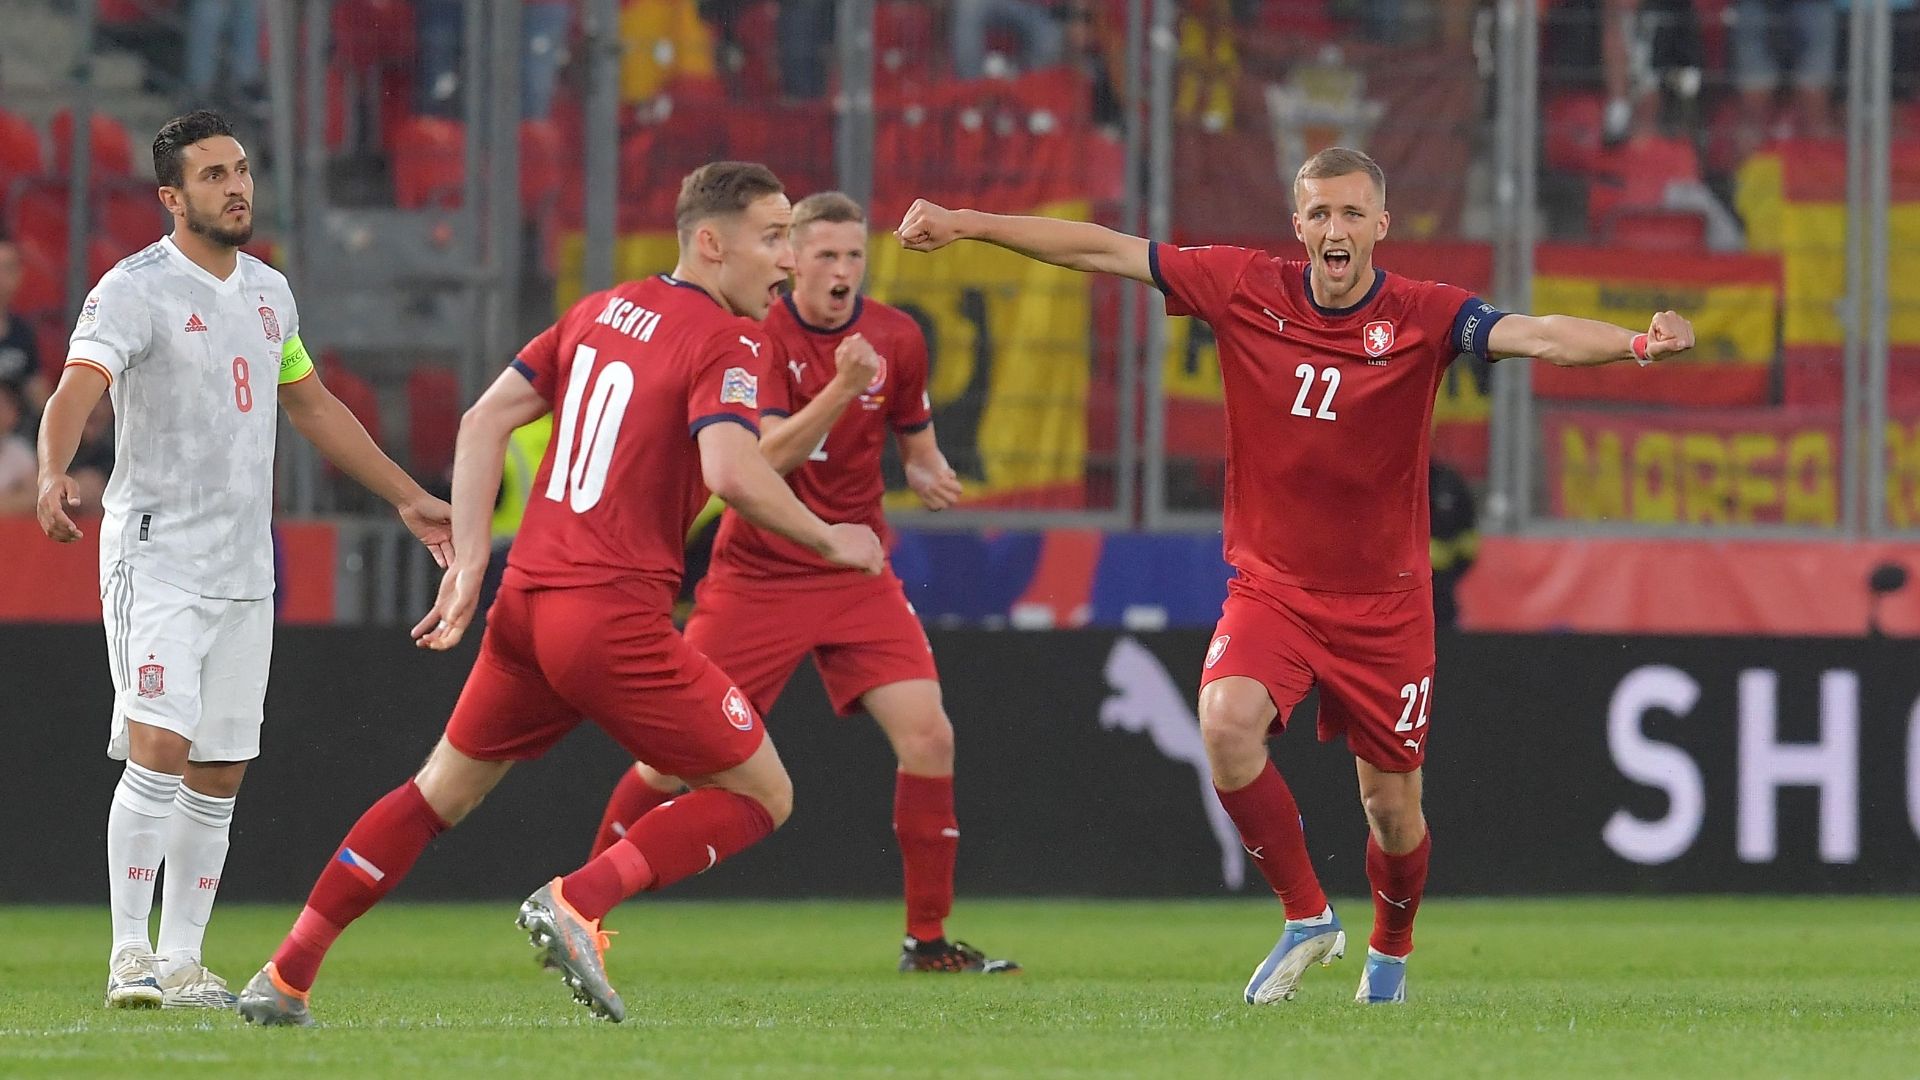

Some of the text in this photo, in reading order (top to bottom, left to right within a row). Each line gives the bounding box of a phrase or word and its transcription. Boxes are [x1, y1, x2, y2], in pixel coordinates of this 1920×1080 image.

[232, 356, 253, 413] 8
[1290, 363, 1342, 421] 22
[545, 343, 635, 514] 10
[1394, 676, 1431, 733] 22
[1602, 664, 1920, 866] SH
